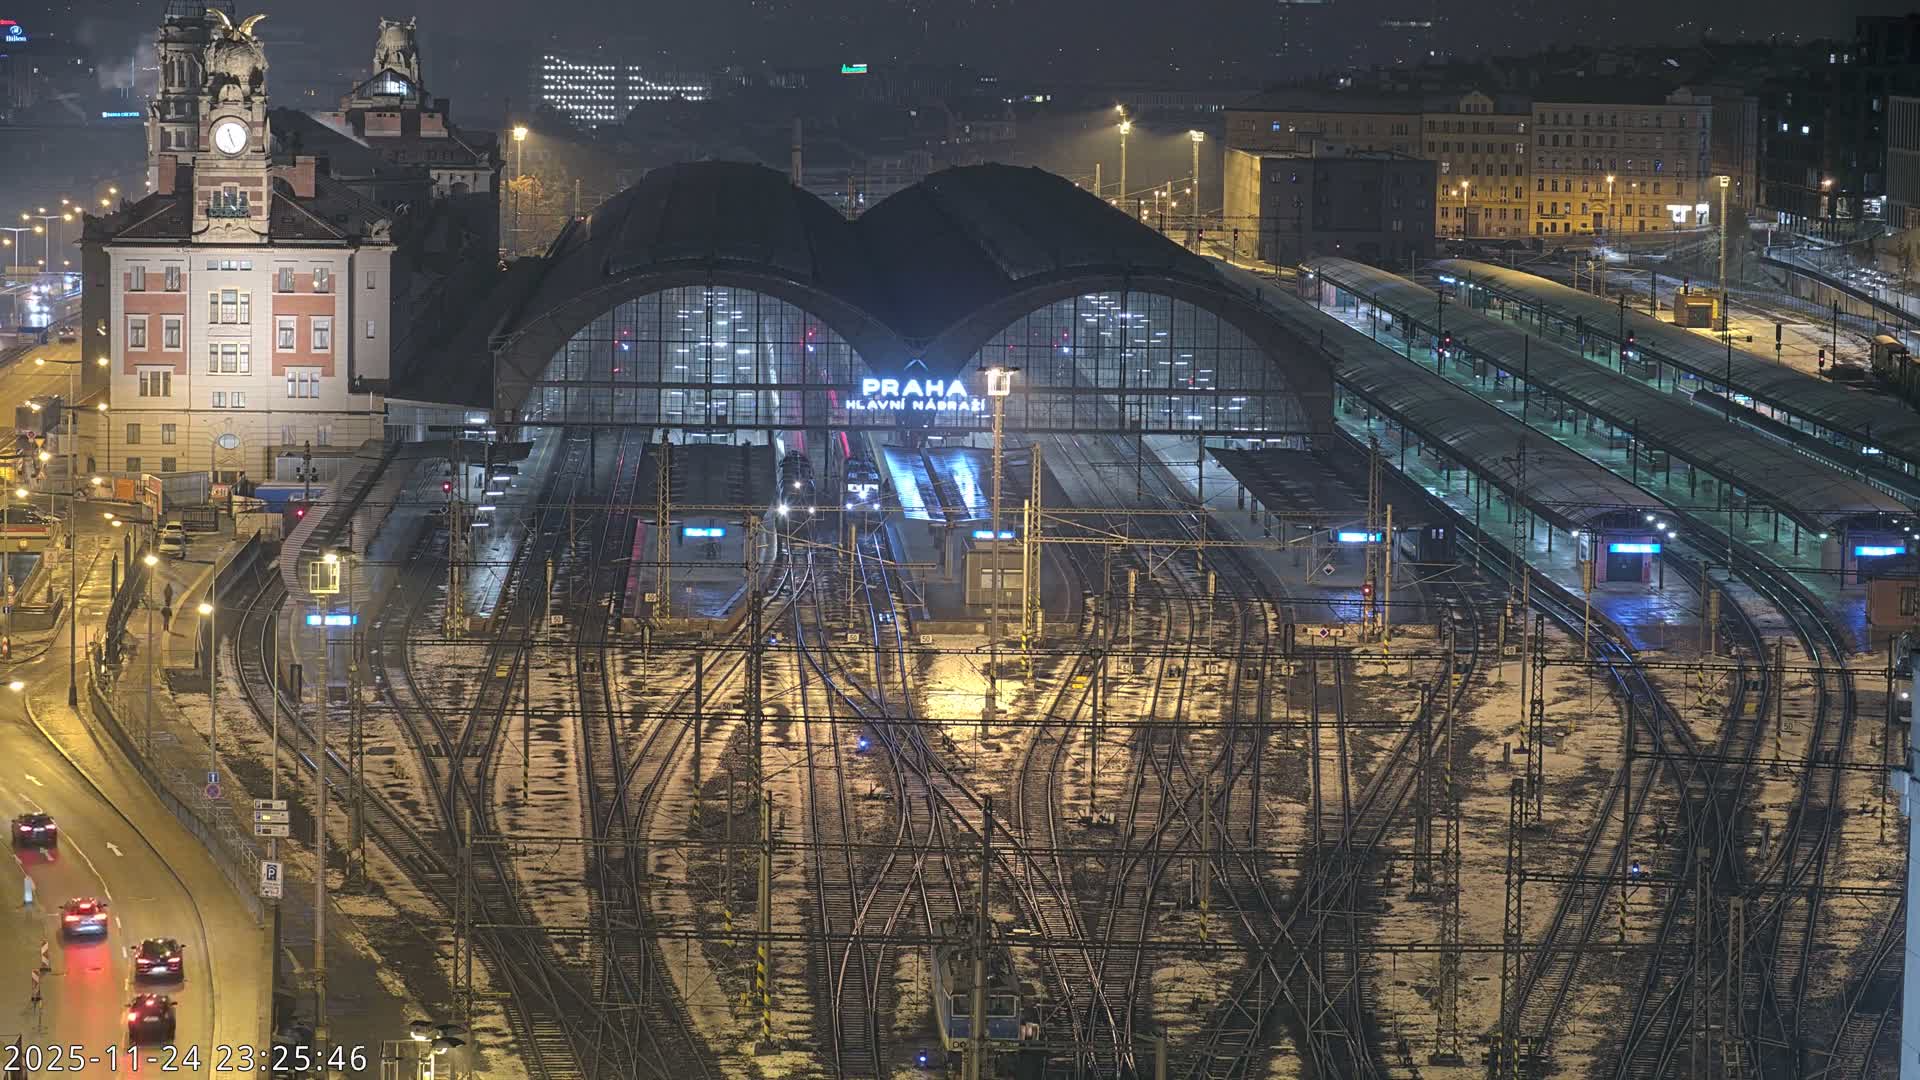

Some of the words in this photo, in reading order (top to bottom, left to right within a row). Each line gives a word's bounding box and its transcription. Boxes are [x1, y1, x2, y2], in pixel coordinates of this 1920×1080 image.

[862, 378, 968, 397] PRAHA
[846, 397, 906, 411] HLAVNÍ
[912, 397, 986, 412] NÁDRAŽÍ
[722, 702, 731, 710] 50
[1784, 722, 1793, 730] 50
[268, 868, 276, 878] P
